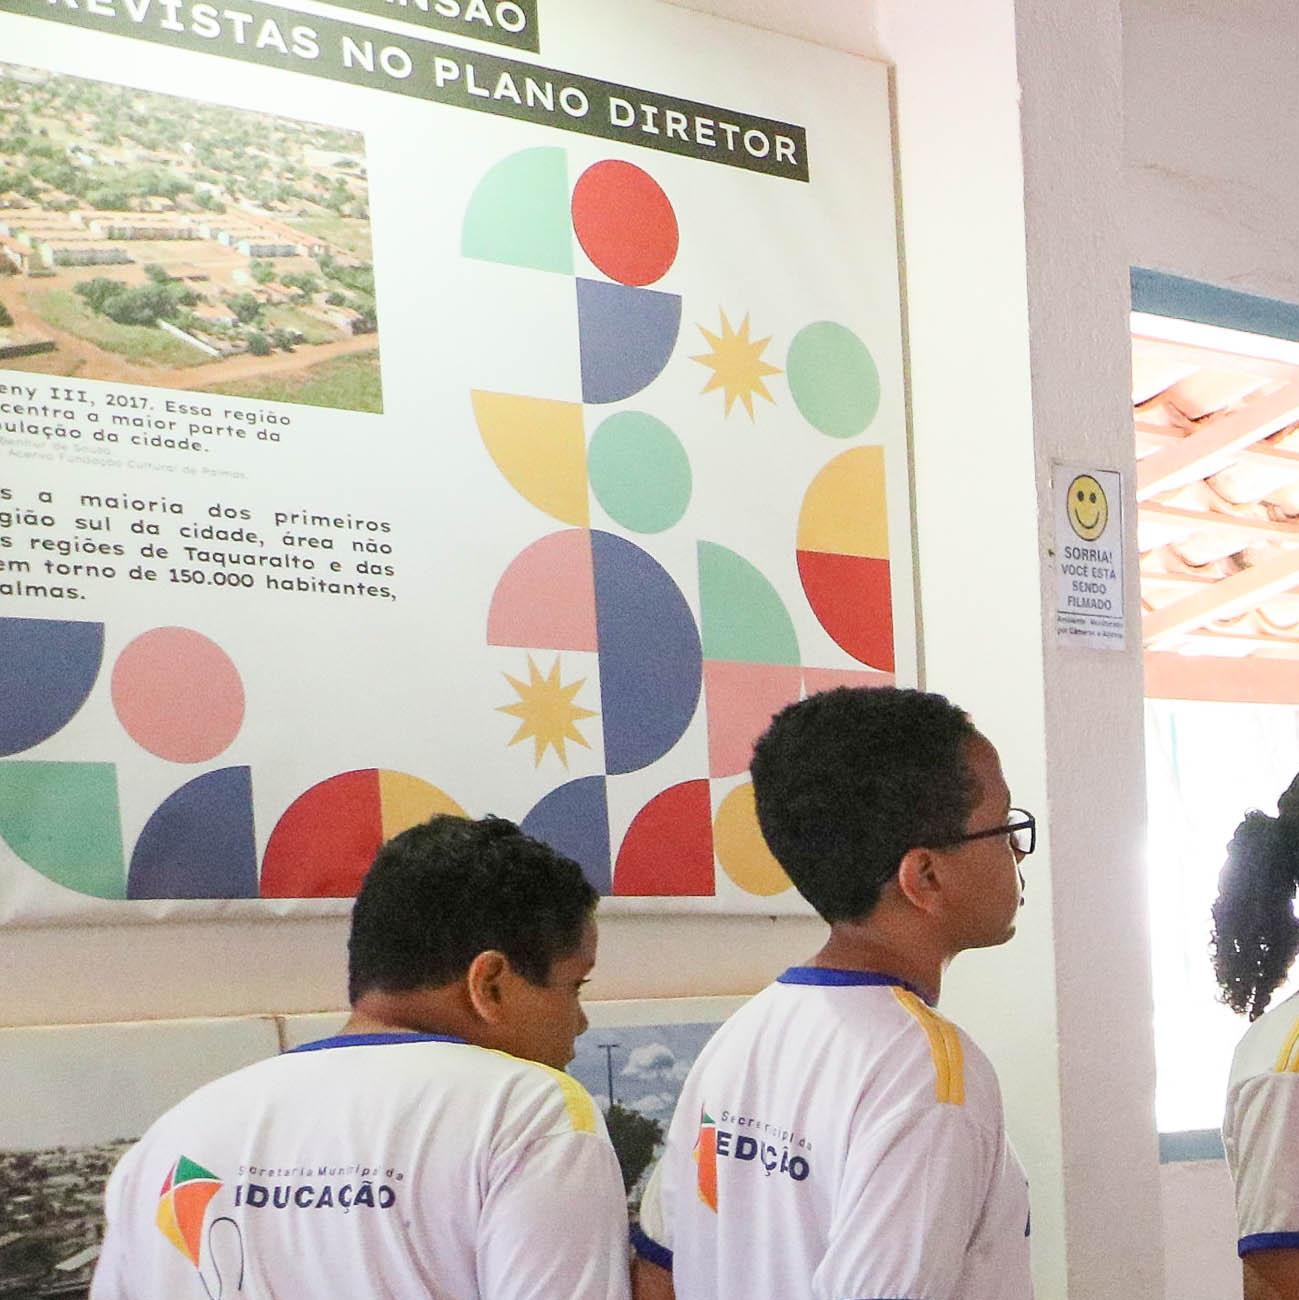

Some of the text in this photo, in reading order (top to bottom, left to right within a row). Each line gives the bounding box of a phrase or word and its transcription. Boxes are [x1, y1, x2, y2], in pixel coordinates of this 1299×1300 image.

[342, 36, 413, 80] NO
[434, 57, 590, 118] PLANO
[609, 96, 798, 166] DIRETOR
[106, 393, 155, 411] 2017.
[165, 400, 212, 418] Essa
[224, 407, 291, 426] região
[0, 420, 209, 453] ulação da cidade.
[87, 412, 99, 423] a
[111, 413, 177, 431] maior
[188, 421, 247, 440] parte
[256, 428, 281, 443] da
[38, 489, 392, 533] a maioria dos primeiros
[75, 516, 111, 531] sul
[130, 520, 160, 536] da
[179, 523, 265, 547] cidade,
[282, 529, 334, 550] área
[352, 537, 393, 555] não
[30, 535, 125, 556] regiões
[140, 543, 169, 559] de
[185, 546, 316, 572] Taquaralto
[329, 559, 343, 573] e
[356, 559, 395, 577] das
[1064, 546, 1113, 564] SORRIA!
[44, 560, 117, 580] torno
[129, 566, 157, 583] de
[169, 568, 255, 589] 150.000
[266, 575, 398, 602] habitantes,
[1072, 581, 1107, 595] SENDO
[1067, 596, 1112, 611] FILMADO
[387, 1167, 403, 1181] da
